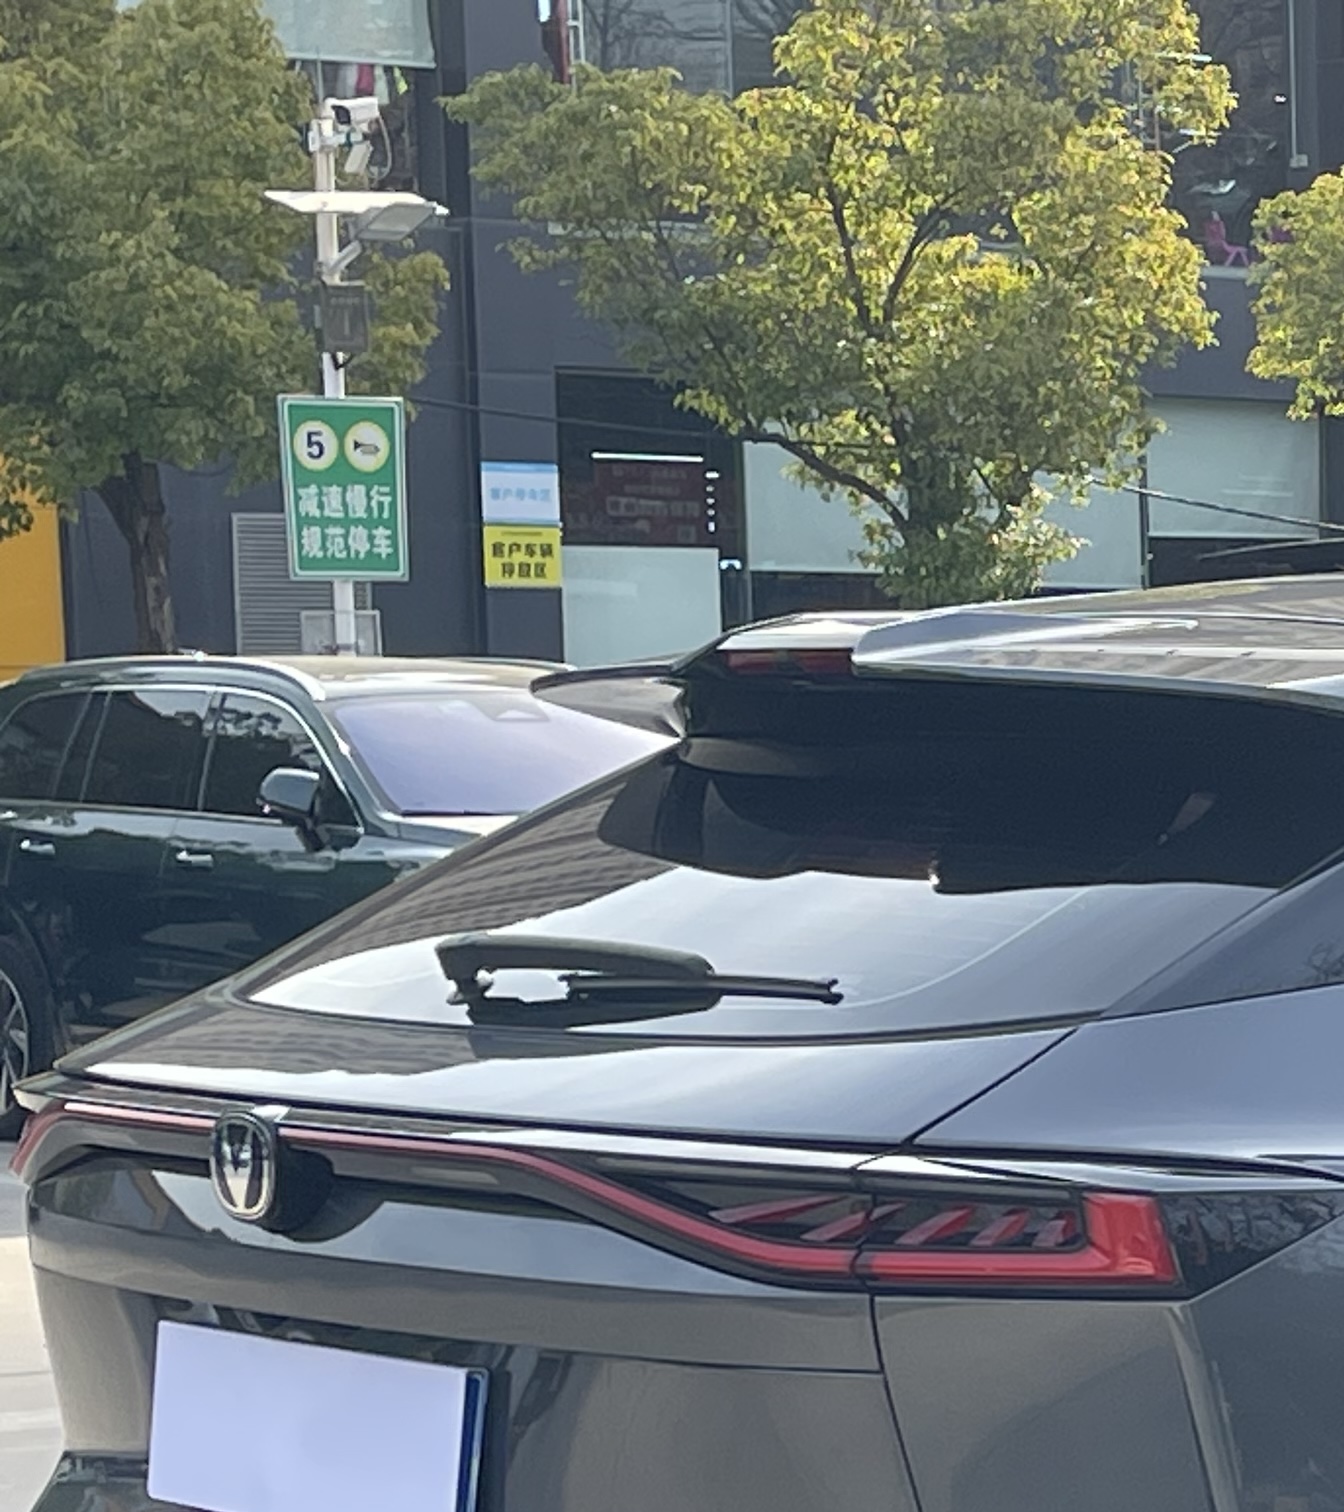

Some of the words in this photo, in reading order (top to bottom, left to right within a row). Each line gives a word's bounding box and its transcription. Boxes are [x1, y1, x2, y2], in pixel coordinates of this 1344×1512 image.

[306, 430, 326, 460] 5
[297, 484, 393, 519] 减速慢行
[301, 524, 394, 560] 规范停车
